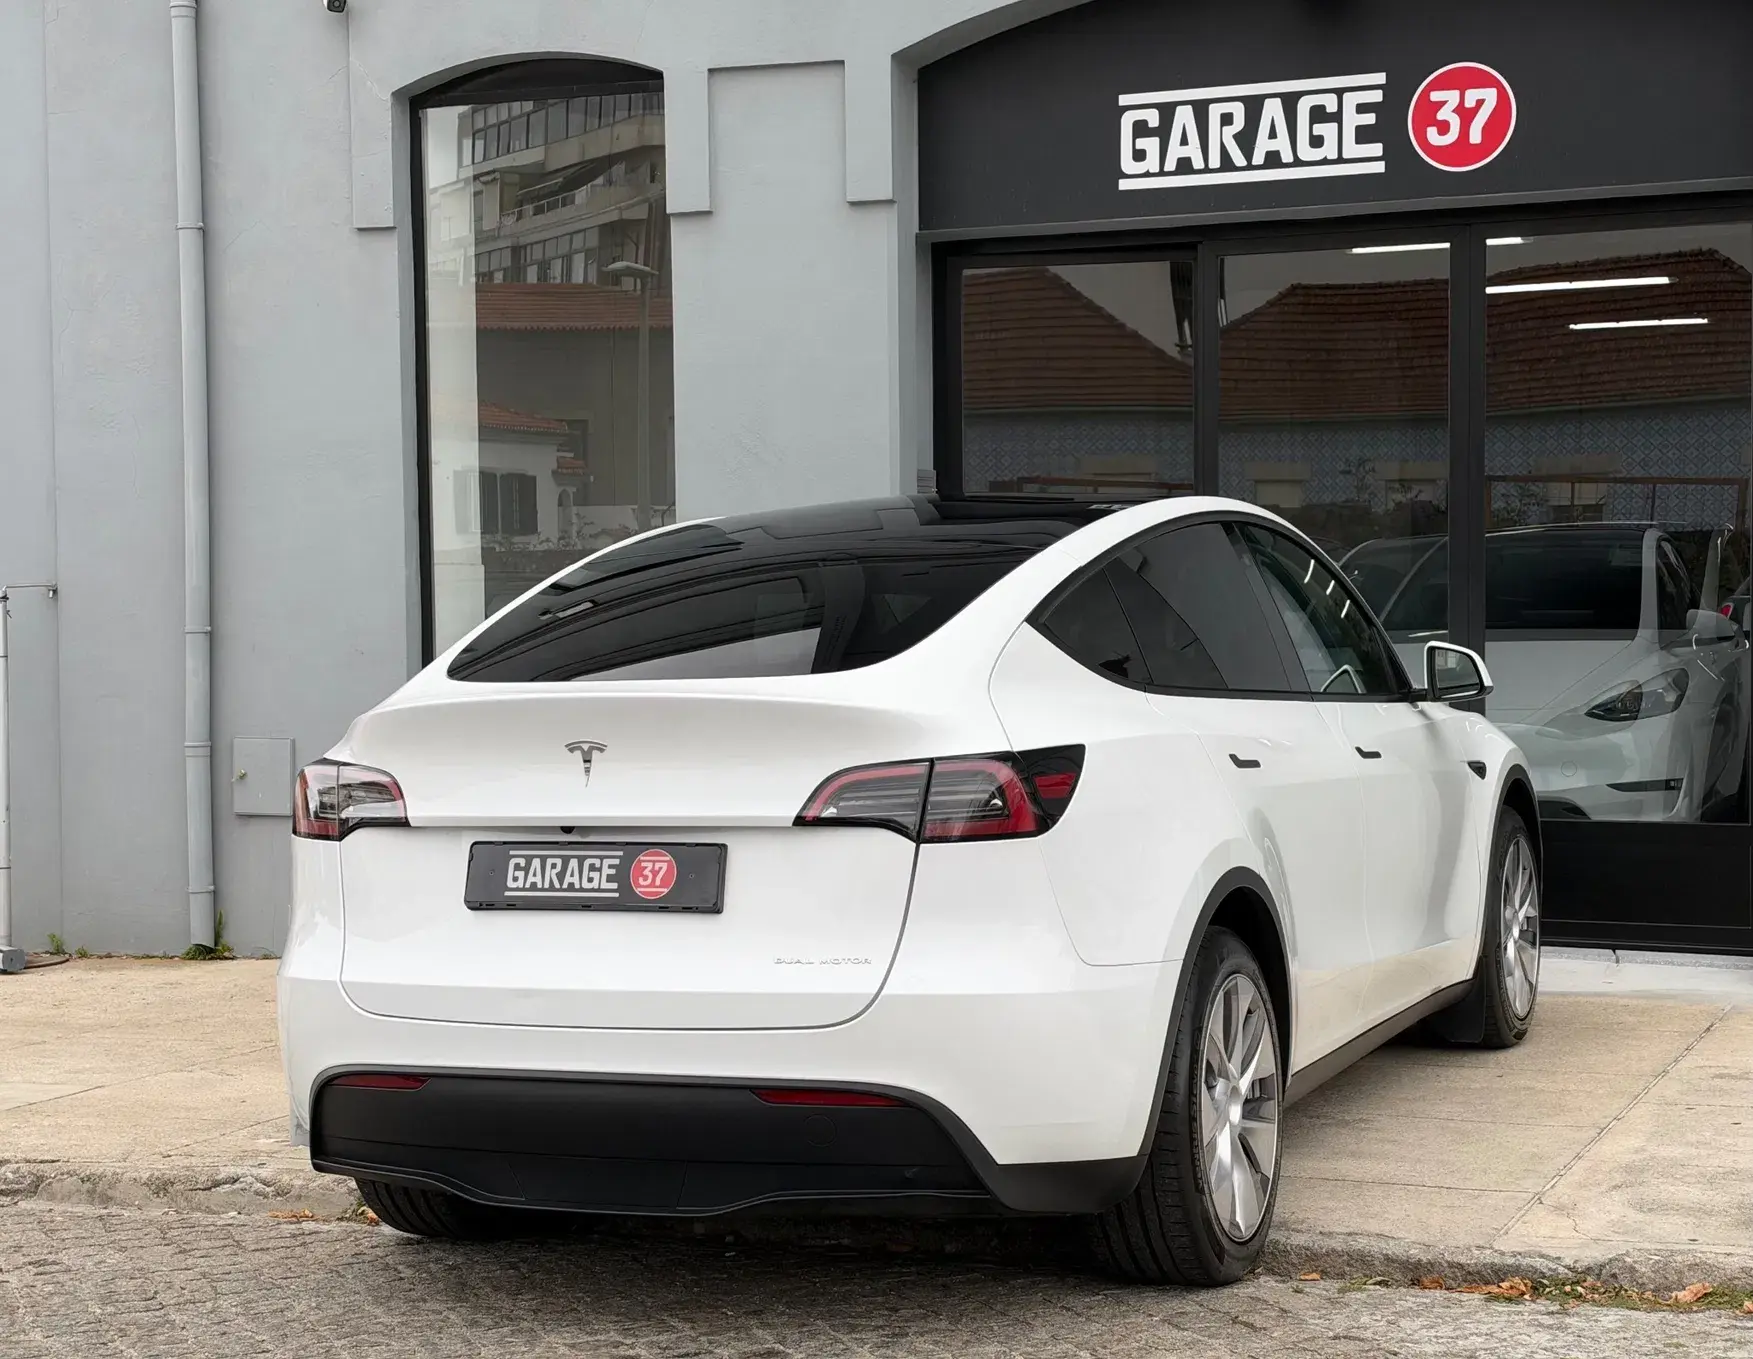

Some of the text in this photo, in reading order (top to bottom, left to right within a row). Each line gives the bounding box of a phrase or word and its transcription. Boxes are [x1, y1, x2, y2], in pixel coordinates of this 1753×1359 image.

[1120, 87, 1497, 174] GARAGE 37
[506, 857, 668, 889] GARAGE 37
[773, 956, 872, 966] DUAL MOTOR
